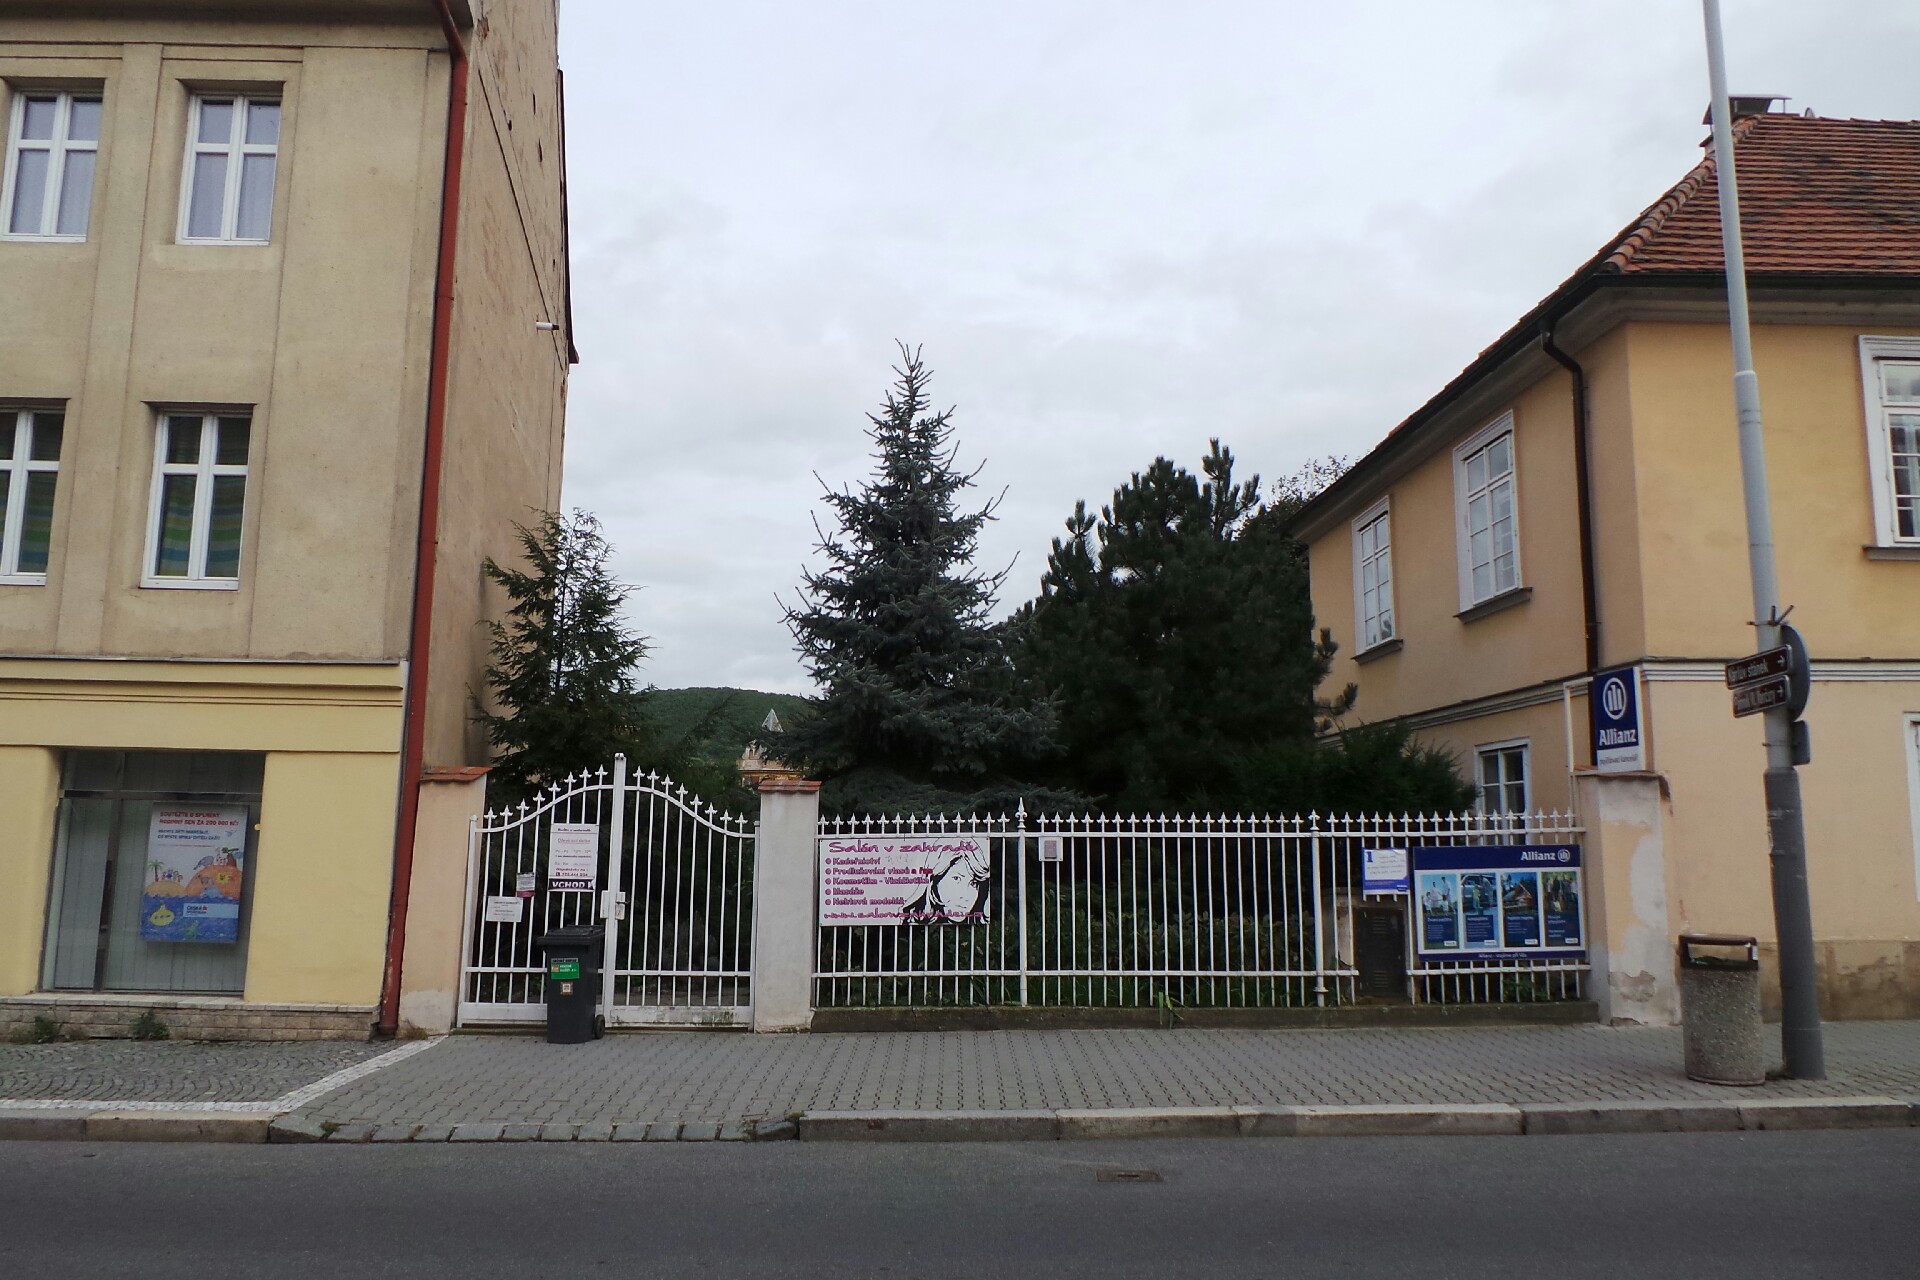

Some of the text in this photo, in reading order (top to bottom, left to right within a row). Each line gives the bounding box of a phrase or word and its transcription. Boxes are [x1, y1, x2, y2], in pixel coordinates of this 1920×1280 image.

[1599, 728, 1637, 746] Allianz
[828, 840, 979, 853] Salón v zahradě
[1520, 851, 1556, 861] Allianz
[832, 857, 881, 865] Kadeřnictví
[832, 867, 885, 875] Prodlužování
[887, 867, 910, 875] vlasů
[552, 881, 585, 889] VCHOD
[832, 877, 878, 885] Kosmetika
[832, 888, 865, 896] Masáže
[832, 898, 868, 906] Nehtová
[824, 907, 984, 919] www.salonvzahrade.cz
